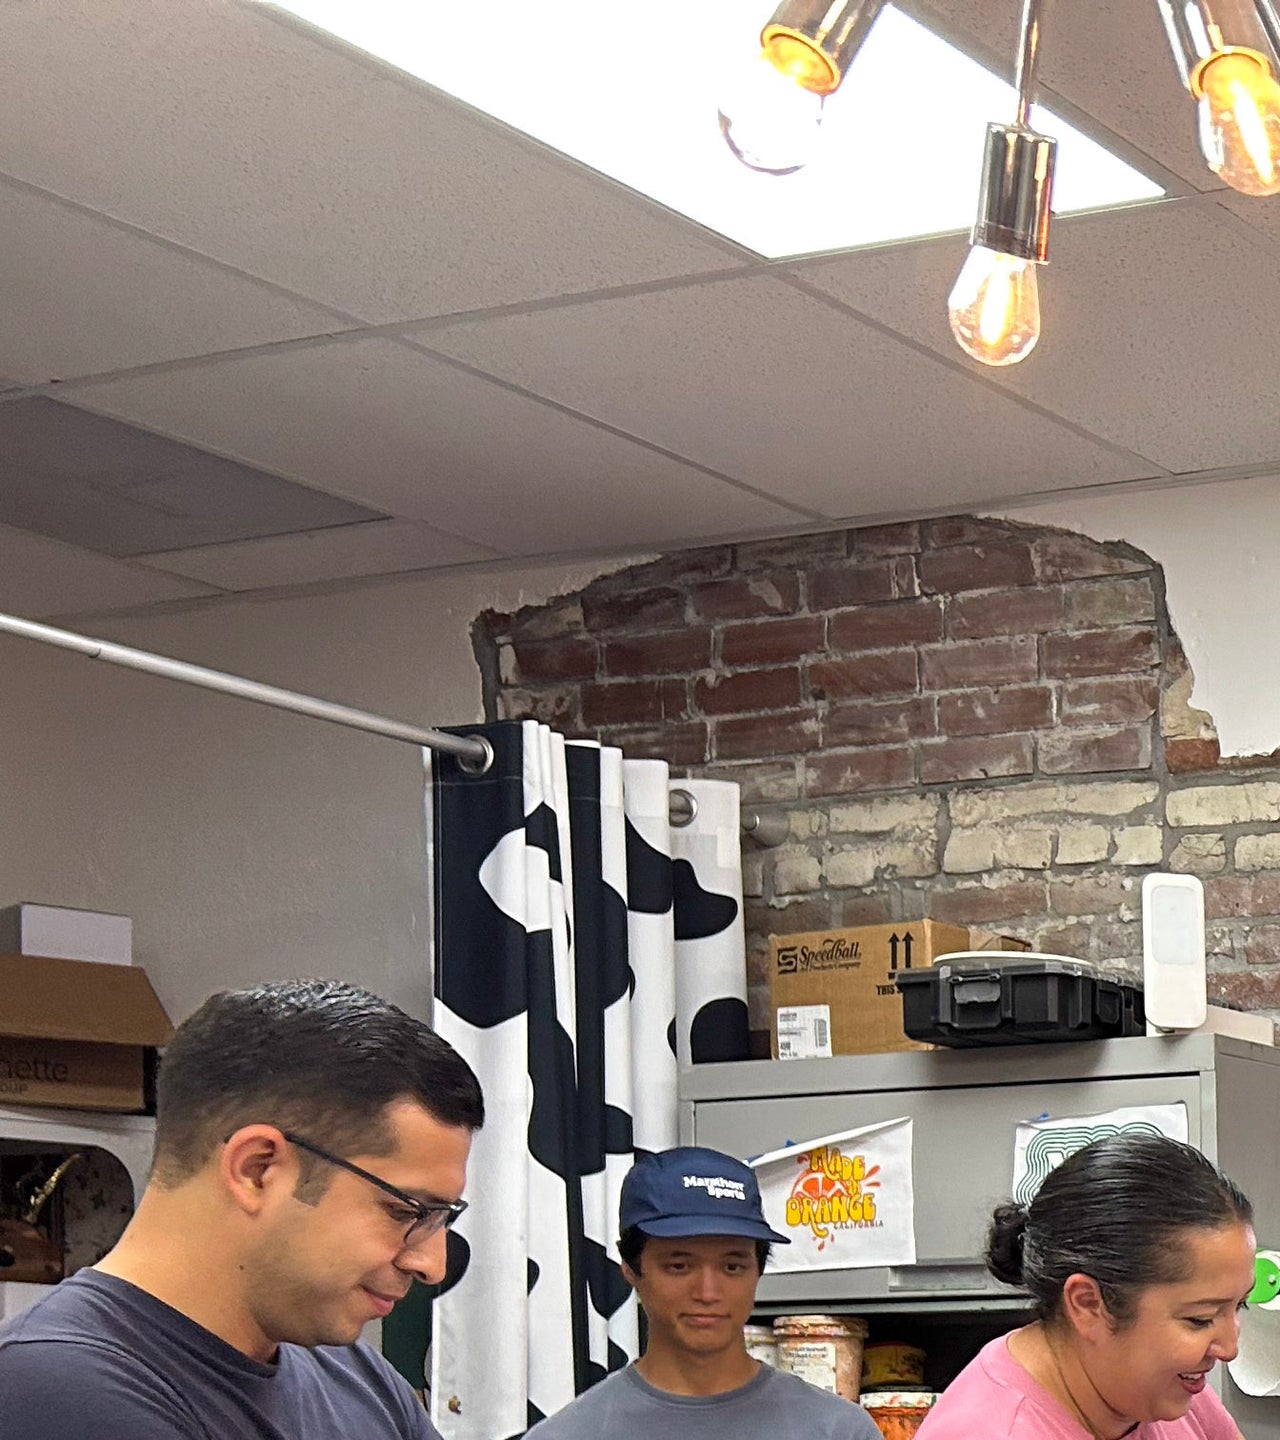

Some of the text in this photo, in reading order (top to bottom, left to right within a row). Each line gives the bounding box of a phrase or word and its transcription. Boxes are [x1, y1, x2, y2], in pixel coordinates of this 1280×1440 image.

[799, 938, 862, 968] Speedball
[810, 1146, 865, 1181] MADE
[786, 1192, 877, 1238] ORANGE
